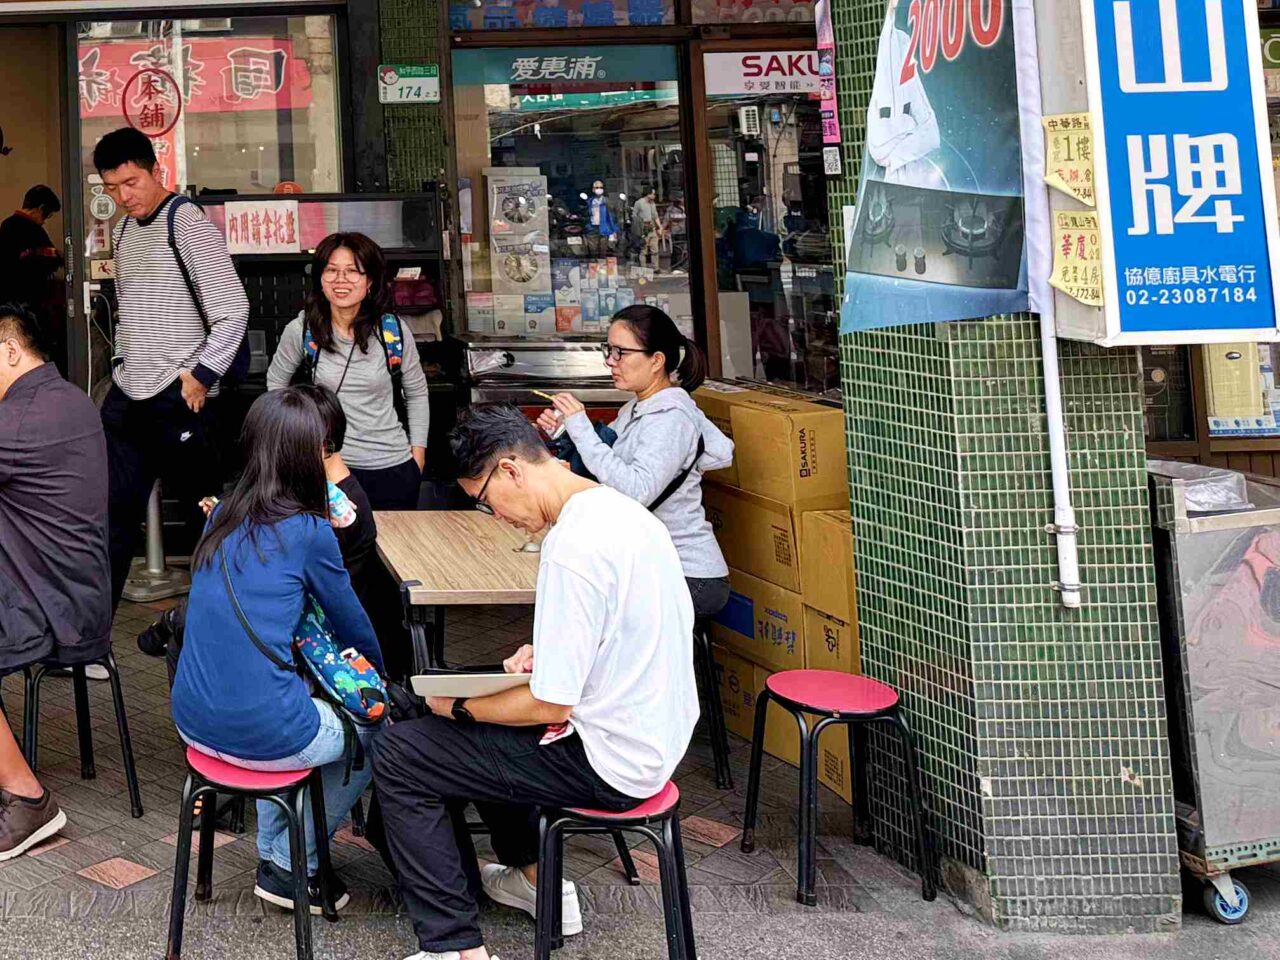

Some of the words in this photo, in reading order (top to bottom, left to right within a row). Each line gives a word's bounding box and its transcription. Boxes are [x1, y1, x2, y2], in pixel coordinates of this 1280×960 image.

[511, 56, 603, 80] 愛惠浦
[398, 86, 422, 99] 174
[1124, 264, 1257, 286] 協億廚具水電行
[1126, 287, 1258, 305] 02-23087184
[798, 428, 809, 469] SAKURA
